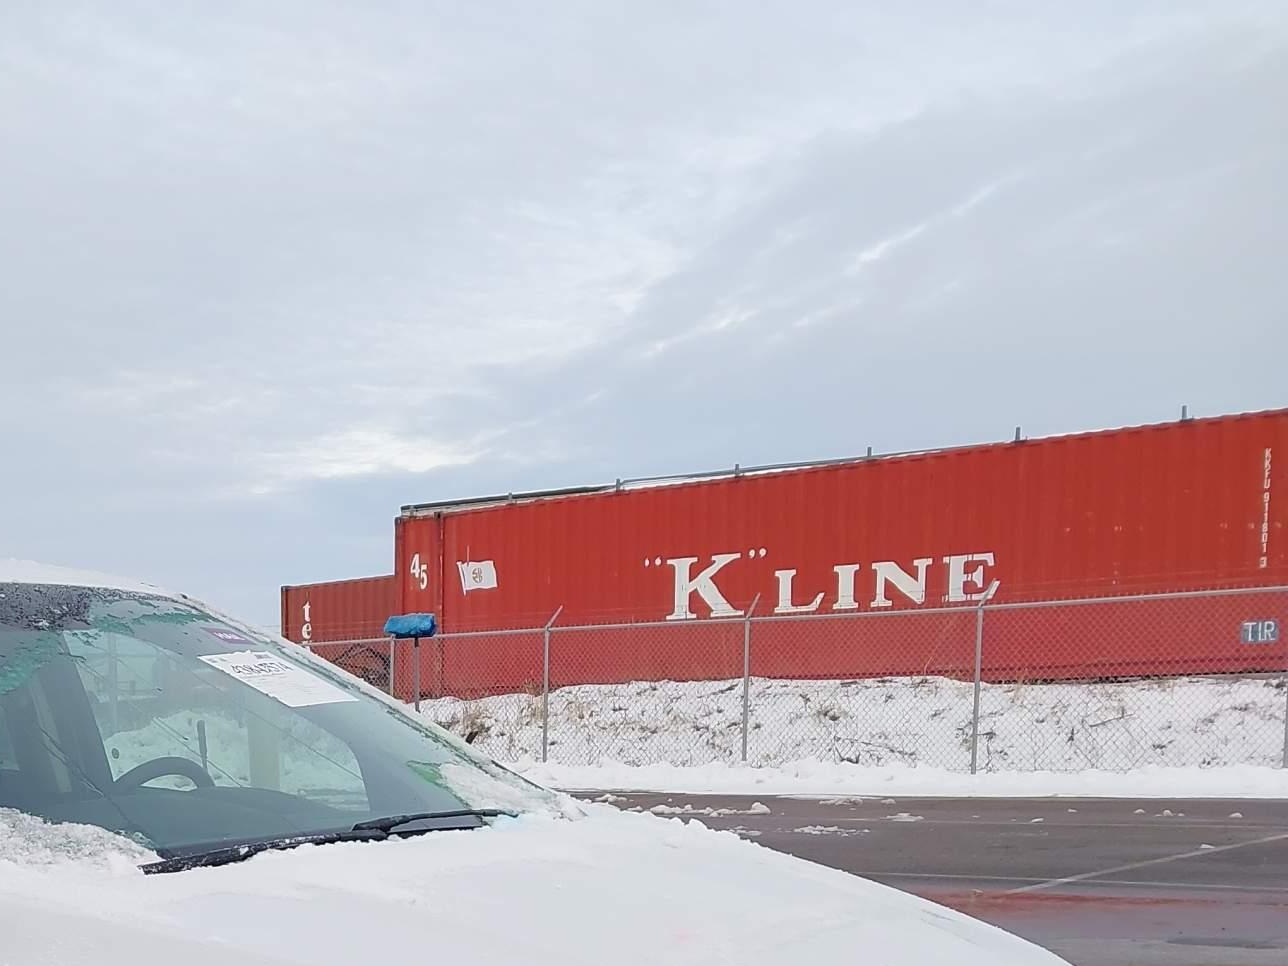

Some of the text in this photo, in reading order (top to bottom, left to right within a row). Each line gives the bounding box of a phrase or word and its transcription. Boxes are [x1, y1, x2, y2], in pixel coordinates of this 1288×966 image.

[410, 552, 429, 590] 45
[773, 551, 1001, 614] LINE
[1242, 620, 1276, 642] TIR
